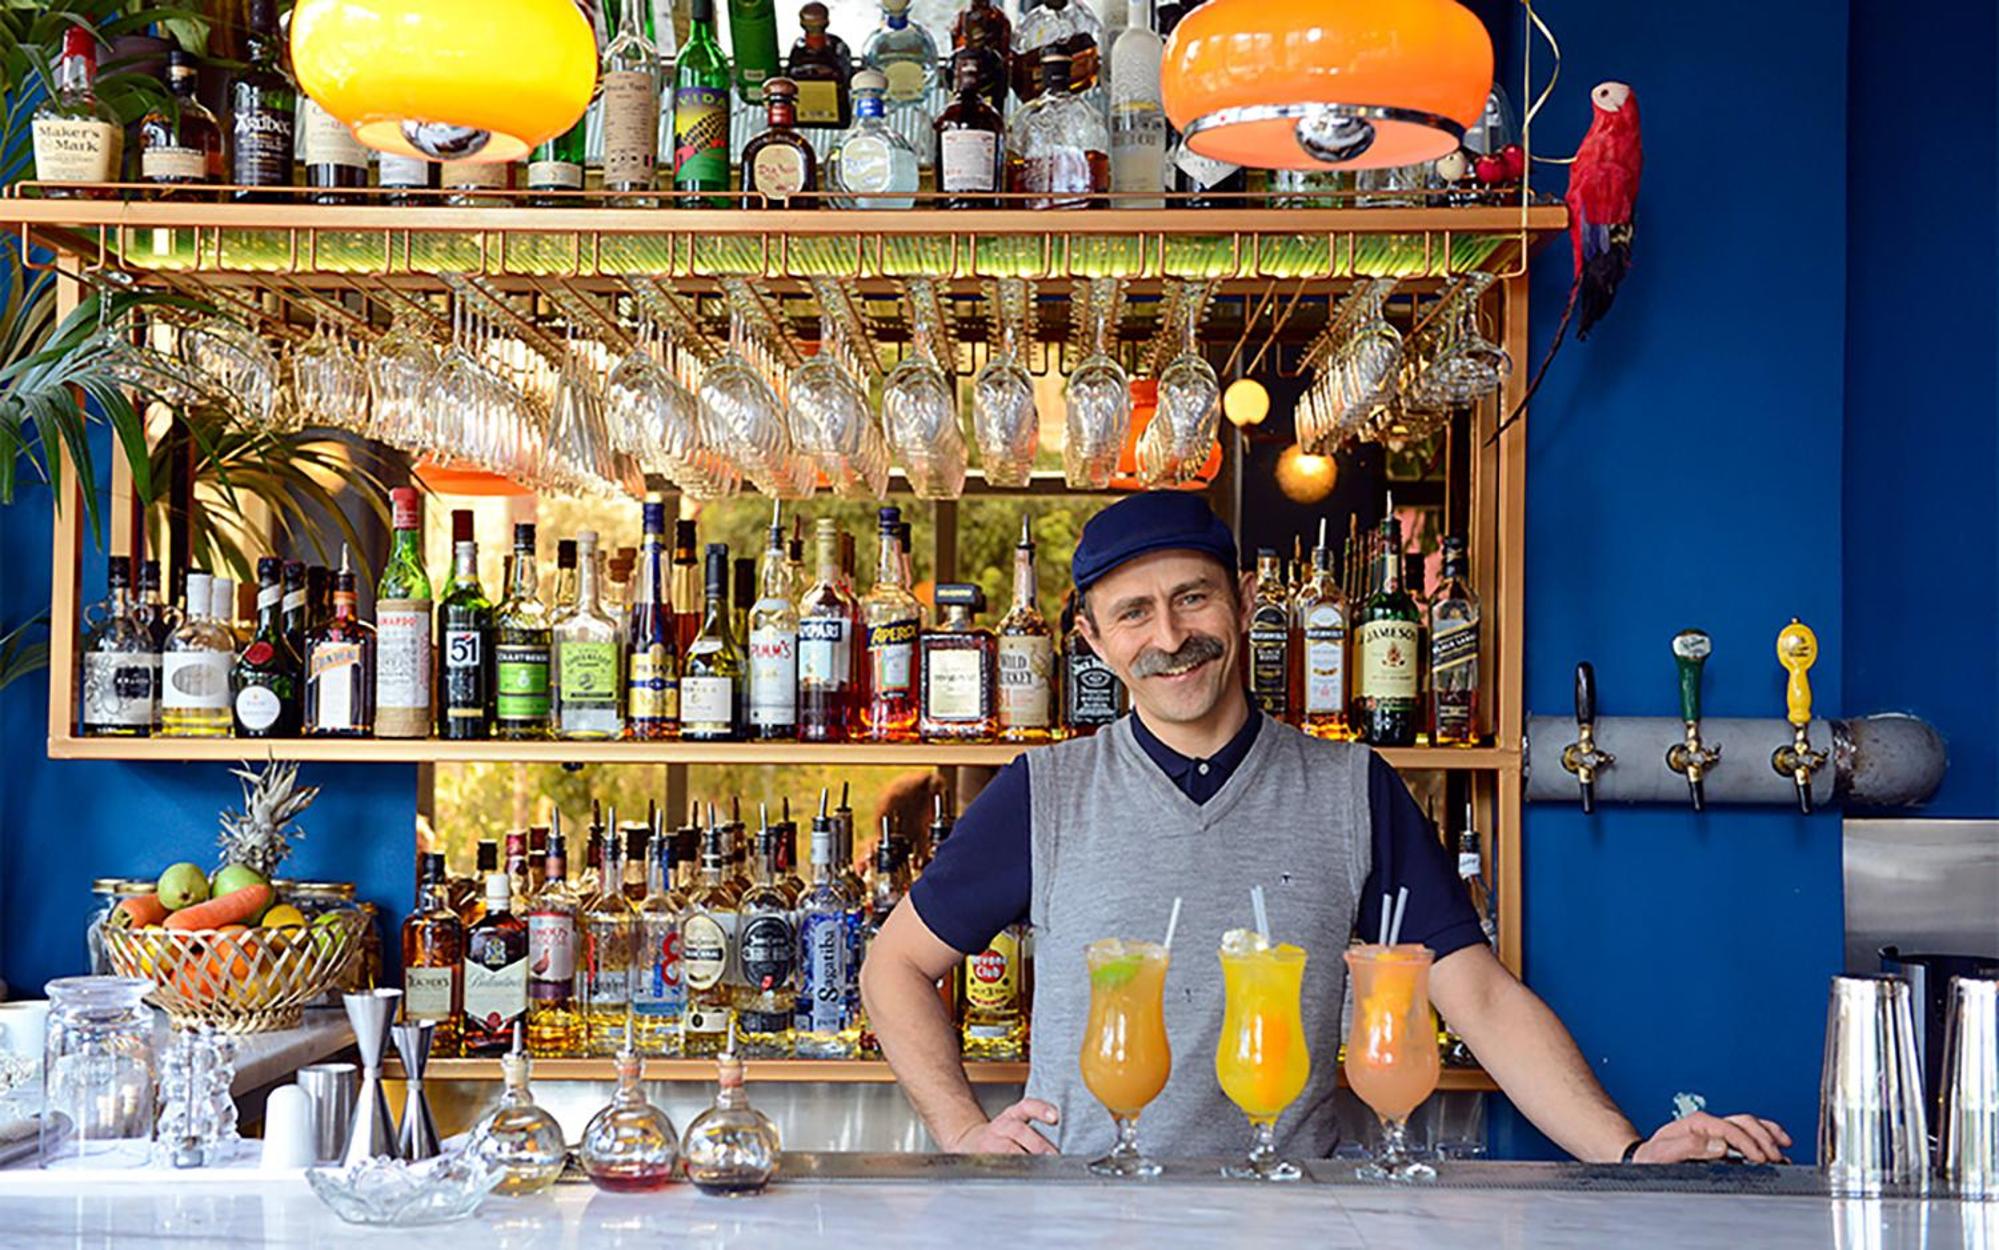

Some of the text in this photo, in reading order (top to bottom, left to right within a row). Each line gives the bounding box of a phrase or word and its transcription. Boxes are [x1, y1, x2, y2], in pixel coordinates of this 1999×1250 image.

[55, 139, 99, 152] Mark
[451, 634, 478, 664] 51
[817, 930, 840, 1003] Sagatiba
